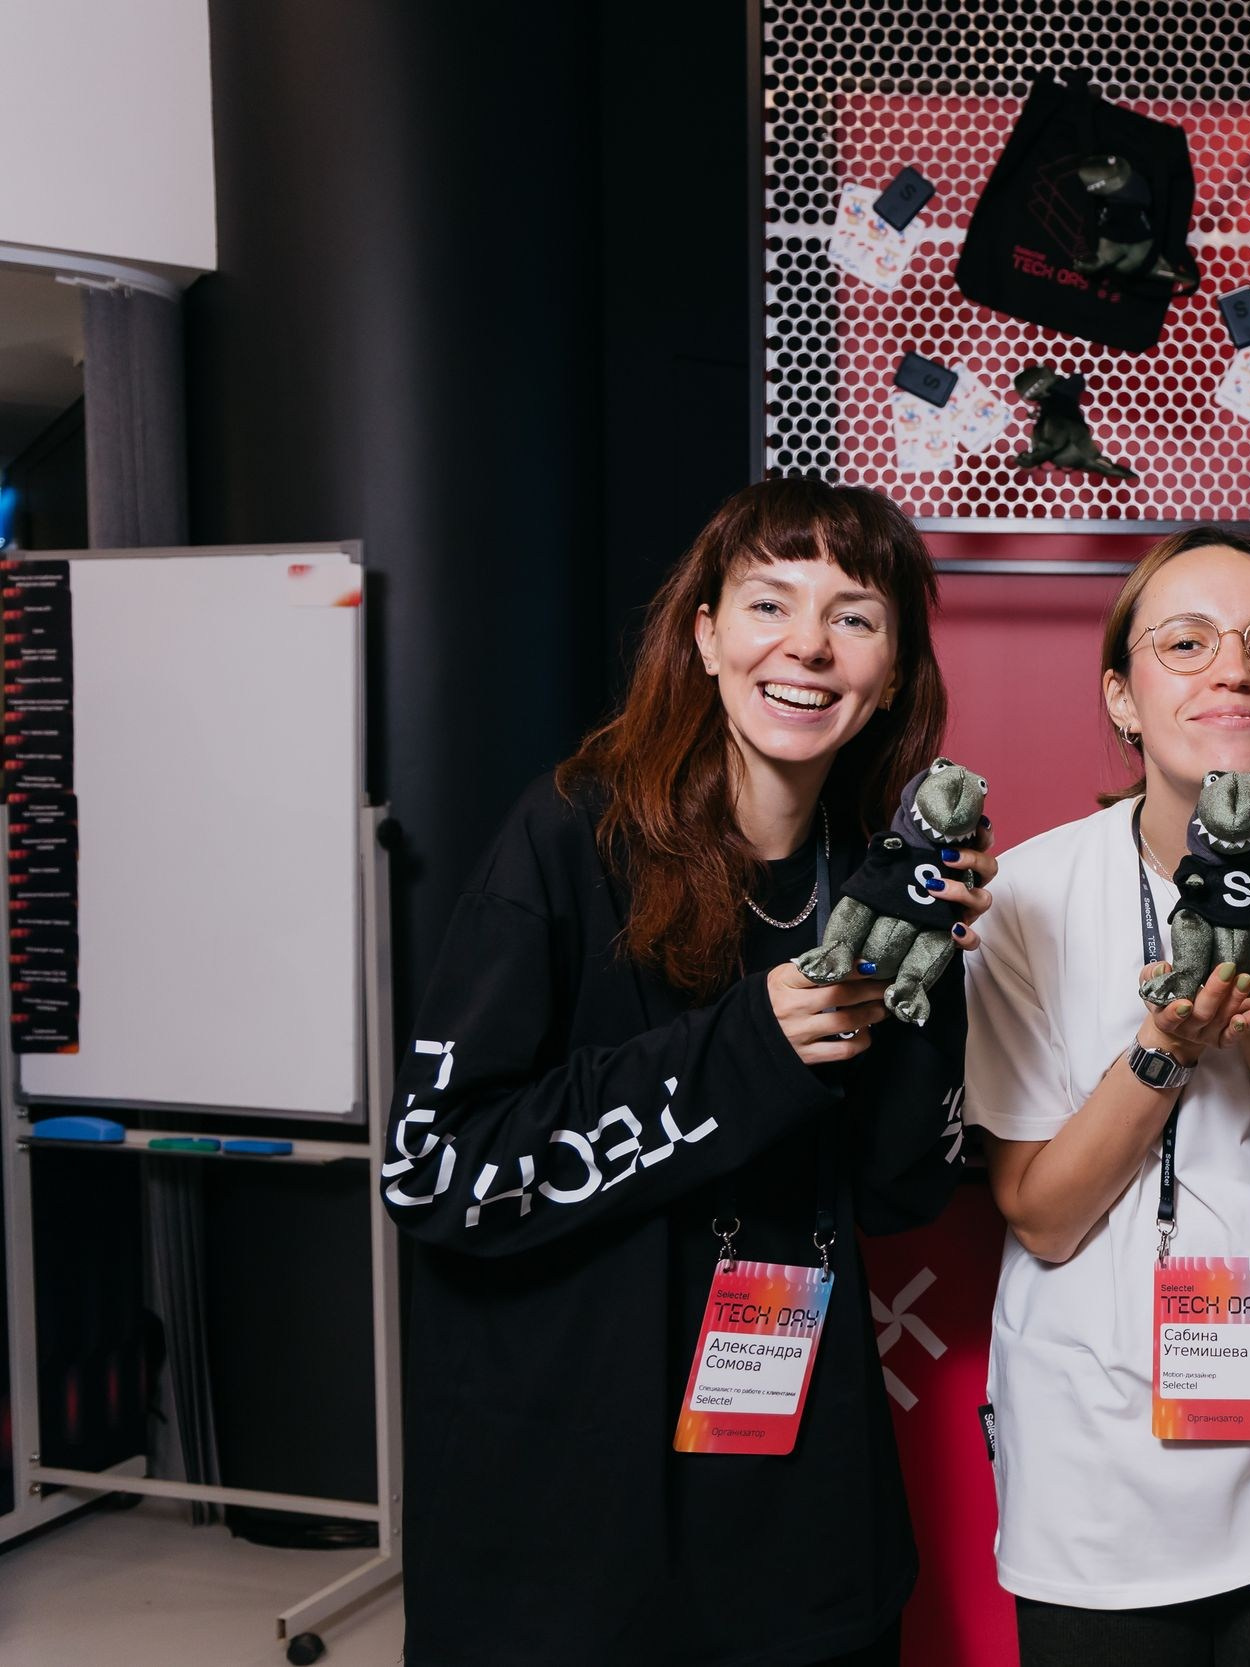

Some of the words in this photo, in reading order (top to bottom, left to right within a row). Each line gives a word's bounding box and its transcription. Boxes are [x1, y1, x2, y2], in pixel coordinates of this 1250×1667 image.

[1013, 253, 1054, 279] TECH
[1143, 897, 1154, 929] Selectel
[1147, 935, 1157, 957] TECH
[465, 1076, 719, 1228] TECH
[1164, 1153, 1172, 1186] Selectel
[717, 1289, 750, 1300] Selectel
[1161, 1284, 1194, 1292] Selectel
[1161, 1295, 1220, 1314] TECH
[714, 1302, 771, 1325] TECH
[776, 1307, 820, 1328] DAY
[1164, 1328, 1218, 1342] Сабина
[709, 1338, 803, 1360] Александра
[1163, 1344, 1248, 1358] Утемишева
[706, 1355, 762, 1371] Сомова
[698, 1385, 733, 1393] Специалист
[742, 1387, 761, 1395] работе
[1162, 1380, 1198, 1390] Selectel
[696, 1394, 733, 1405] Selectel
[1187, 1413, 1244, 1423] Организатор
[711, 1427, 765, 1437] Организатор
